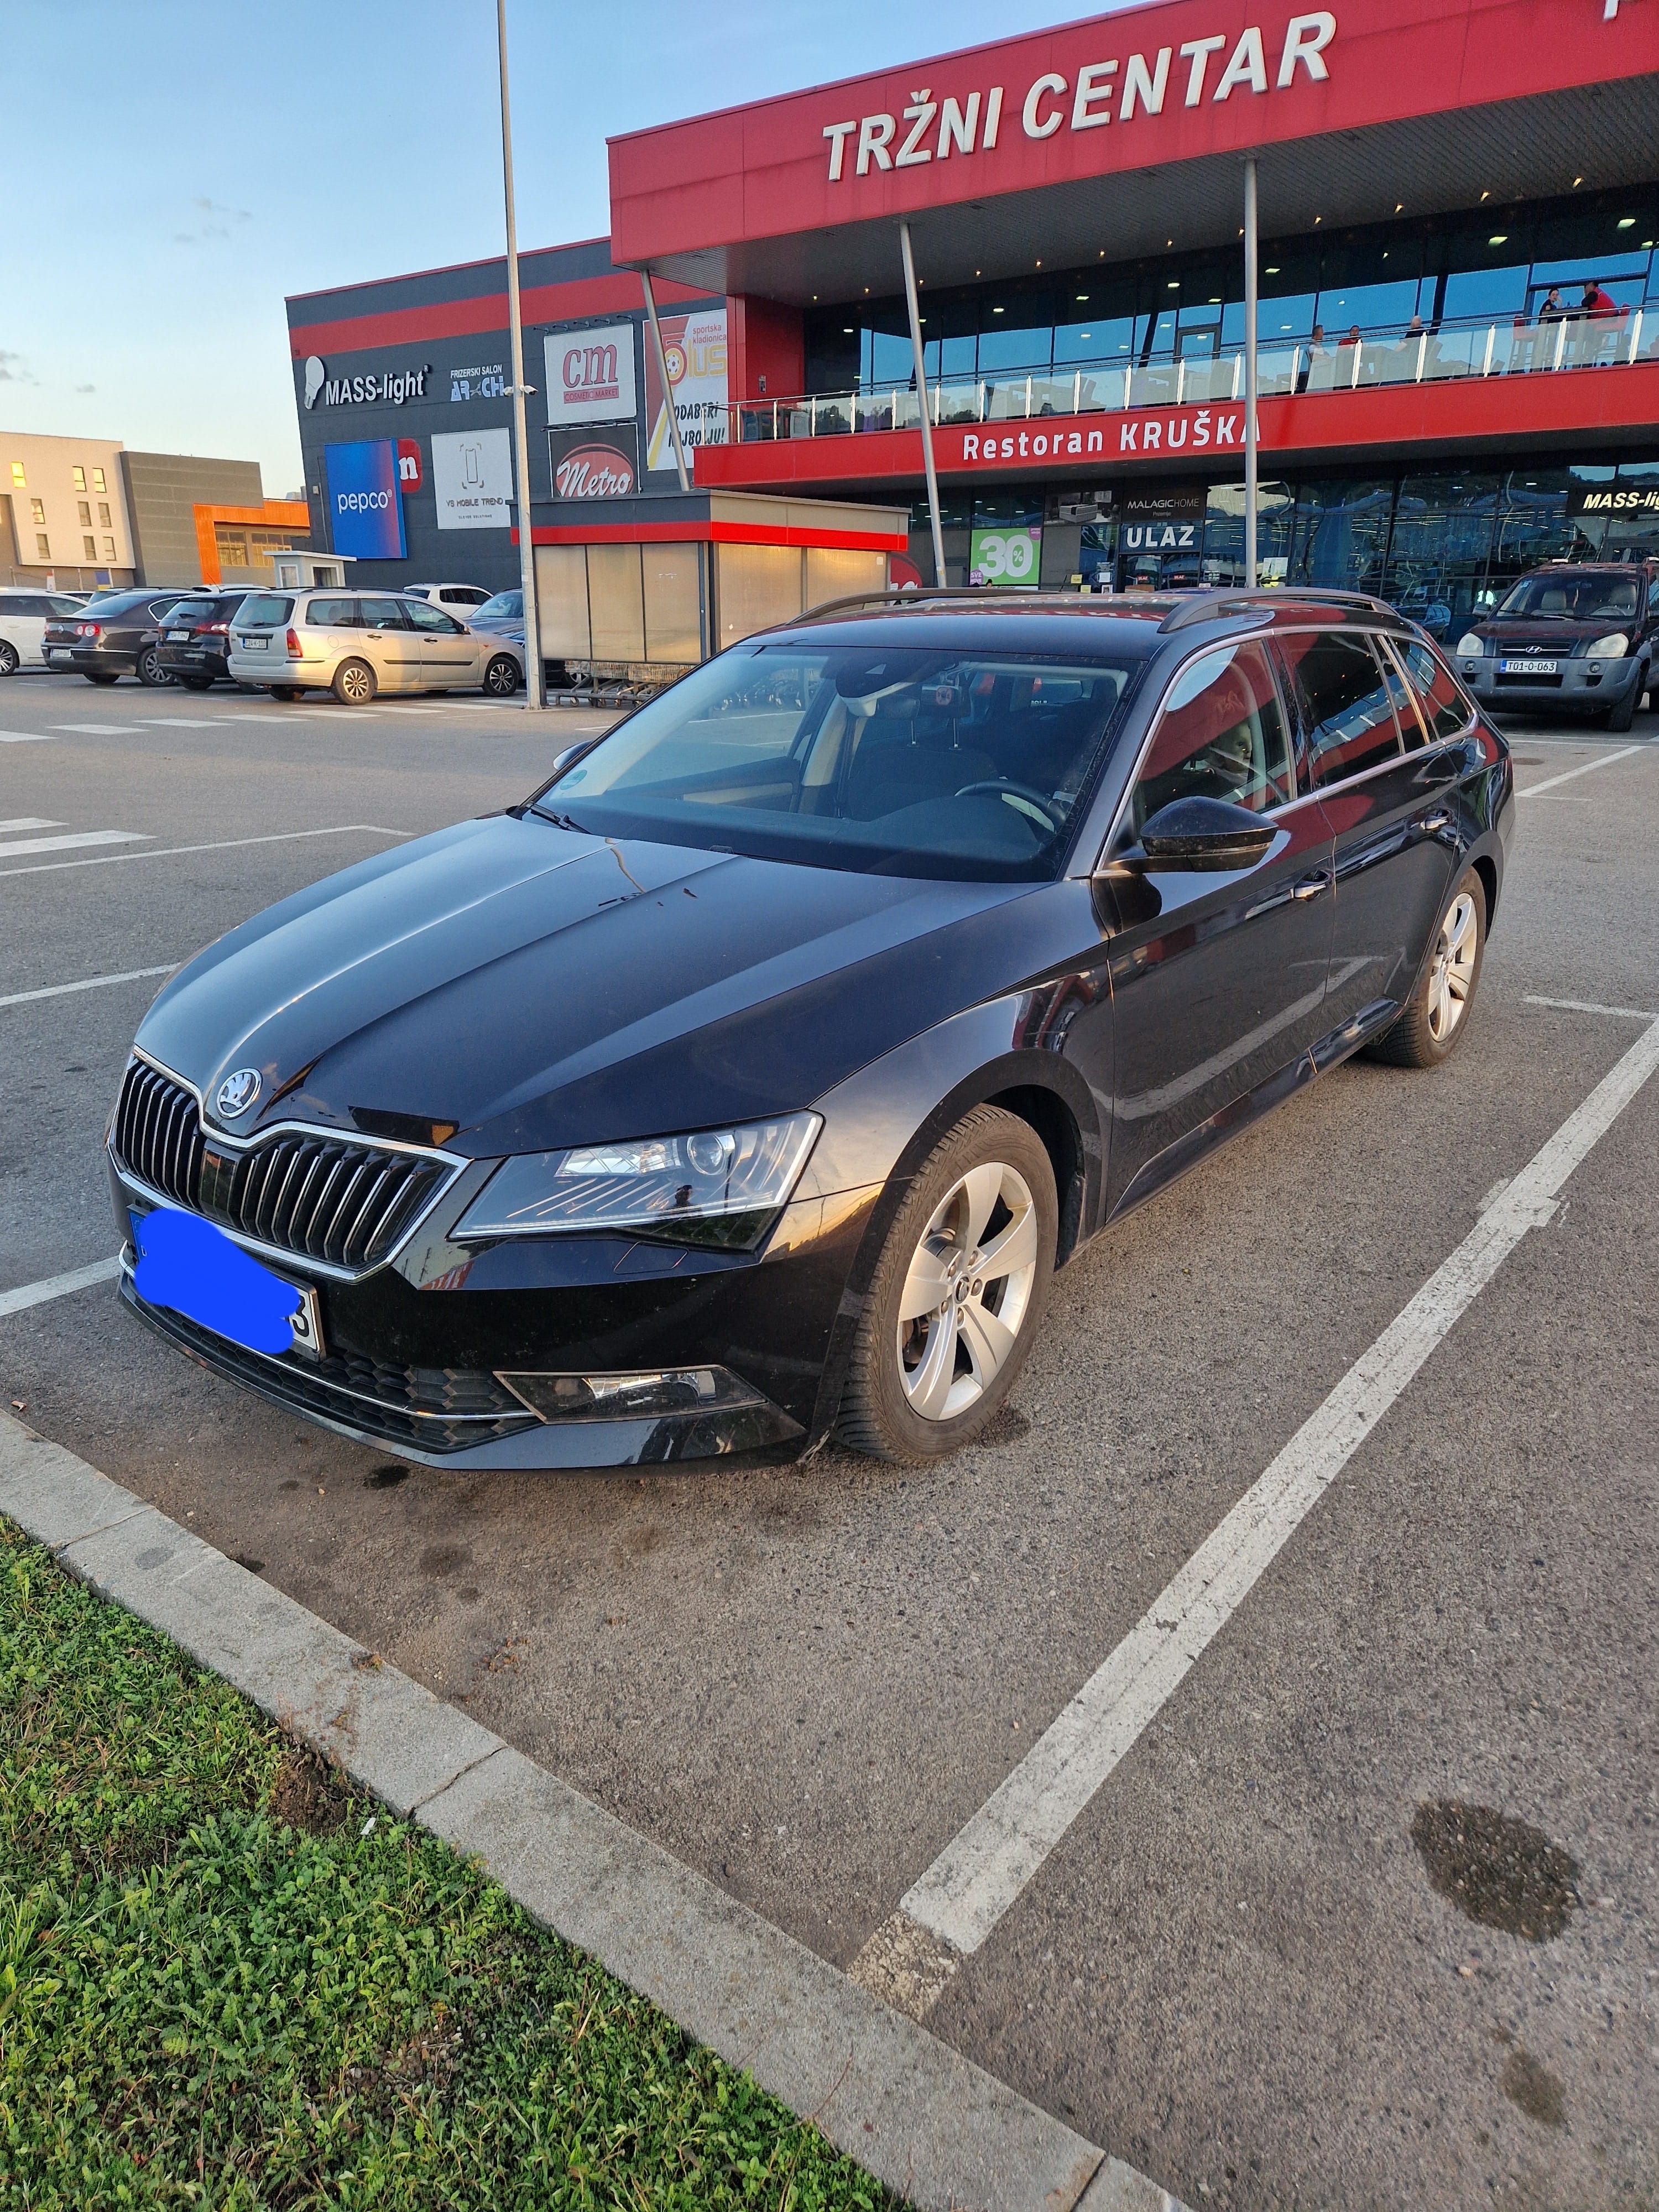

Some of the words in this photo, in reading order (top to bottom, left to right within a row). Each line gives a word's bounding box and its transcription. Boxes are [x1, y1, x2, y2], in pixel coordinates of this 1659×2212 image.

[822, 88, 1004, 182] TRŽNI
[1021, 10, 1337, 141] CENTAR
[693, 324, 722, 335] sportska
[693, 334, 726, 345] kladionica
[450, 367, 481, 379] FRIZERSKI
[481, 364, 502, 374] SALON
[563, 345, 618, 388] cm
[325, 370, 424, 405] MASS-light
[565, 390, 593, 401] COSMETIC
[596, 388, 618, 398] MARKET
[963, 430, 1103, 460] Restoran
[556, 460, 631, 497] Metro
[457, 498, 479, 507] MOBILE
[481, 497, 503, 506] TREND
[1126, 525, 1194, 547] ULAZ
